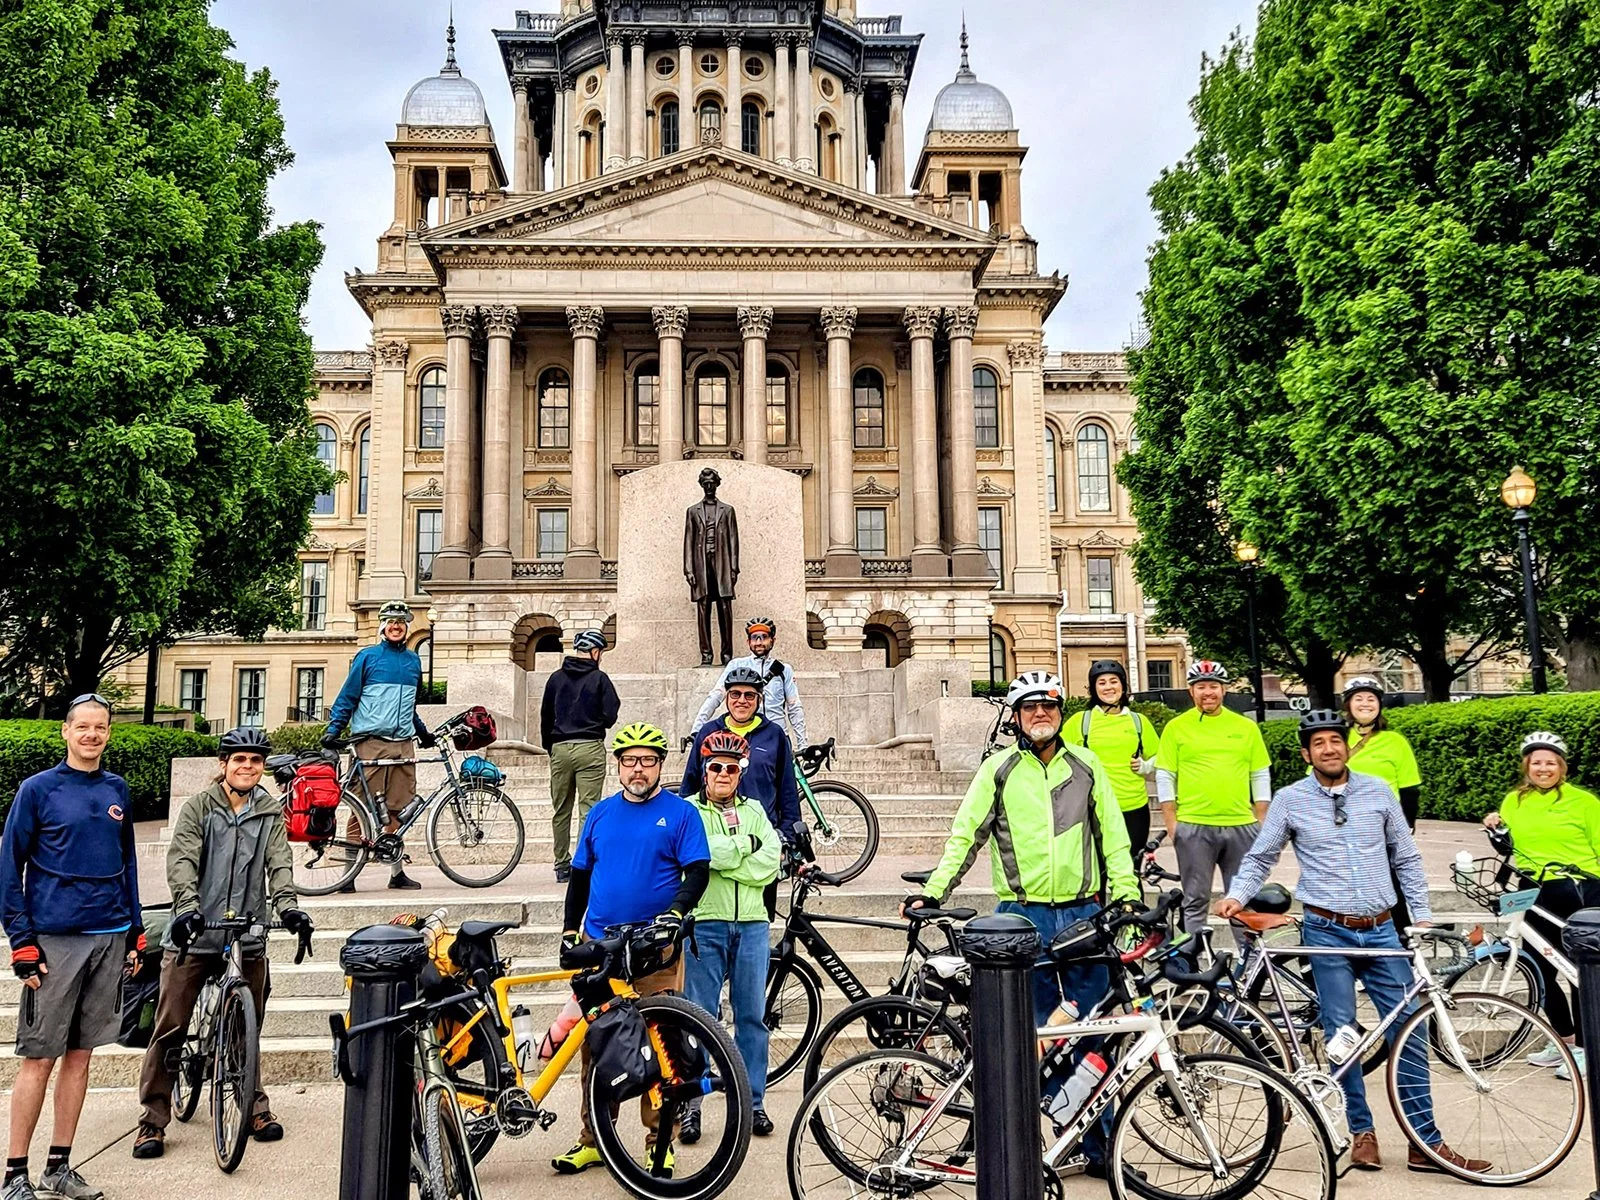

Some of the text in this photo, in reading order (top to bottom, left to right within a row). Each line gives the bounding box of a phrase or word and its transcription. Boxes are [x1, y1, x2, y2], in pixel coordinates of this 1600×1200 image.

[107, 804, 124, 821] C
[820, 954, 863, 998] AVENTON
[1071, 1060, 1136, 1132] TREK
